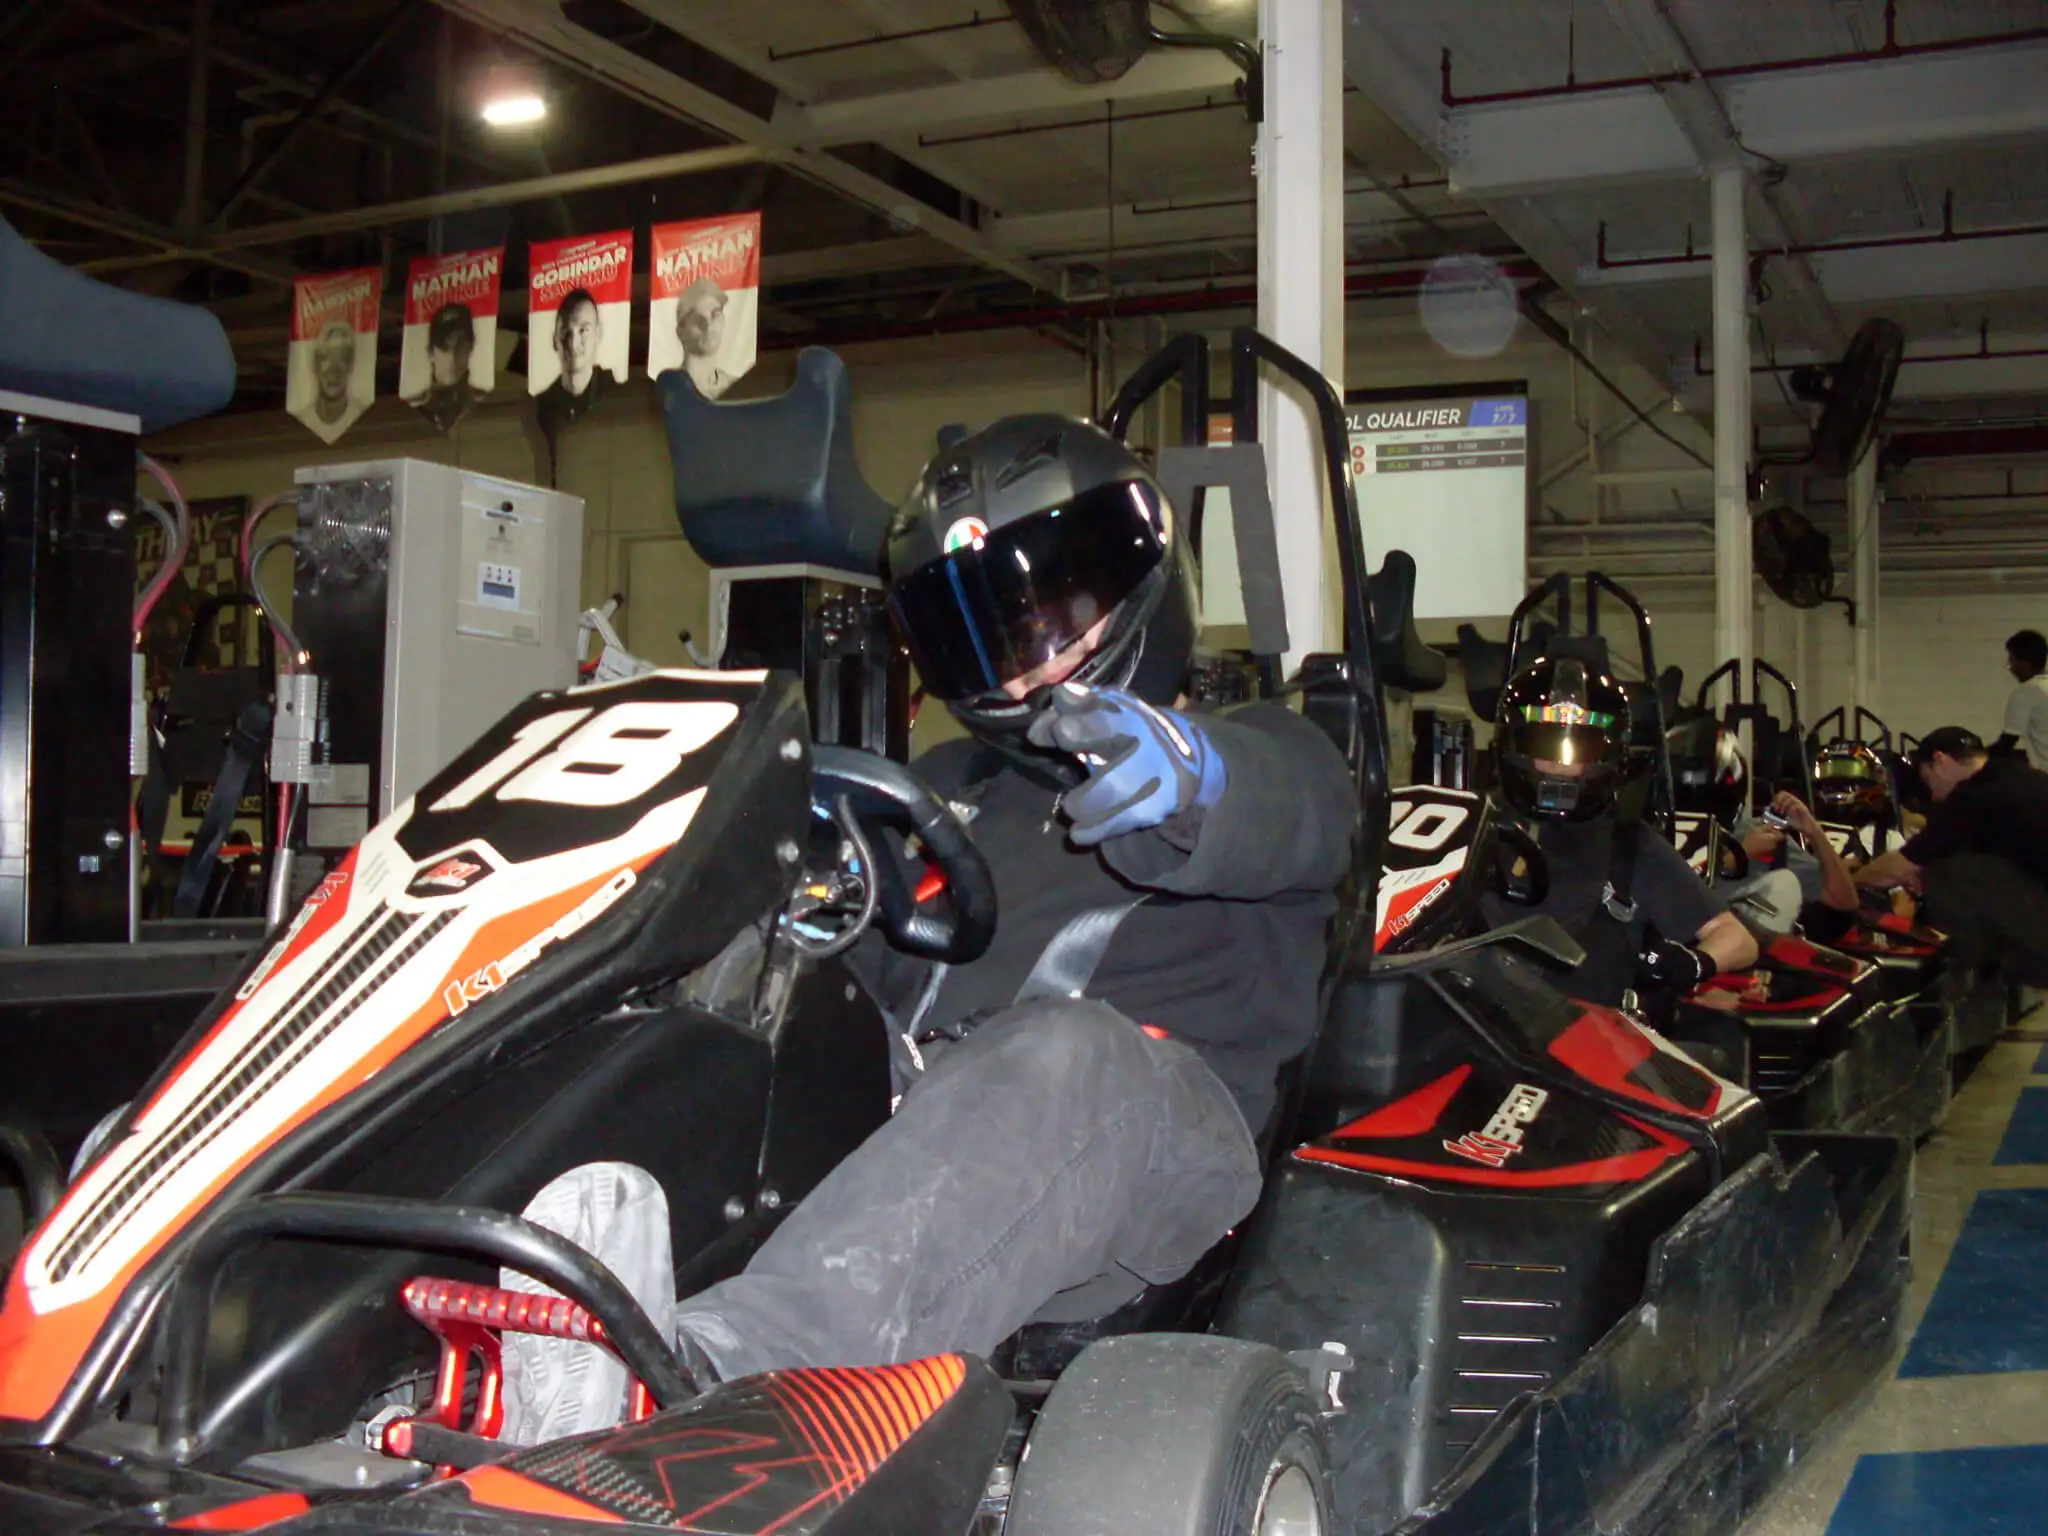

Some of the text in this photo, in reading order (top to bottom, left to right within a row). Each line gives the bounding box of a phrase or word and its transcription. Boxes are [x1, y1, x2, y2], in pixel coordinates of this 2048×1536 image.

[533, 246, 627, 289] GOBINDAR
[657, 229, 753, 277] NATHAN
[412, 256, 498, 302] NATHAN
[1367, 408, 1461, 430] QUALIFIER
[428, 700, 739, 812] 18
